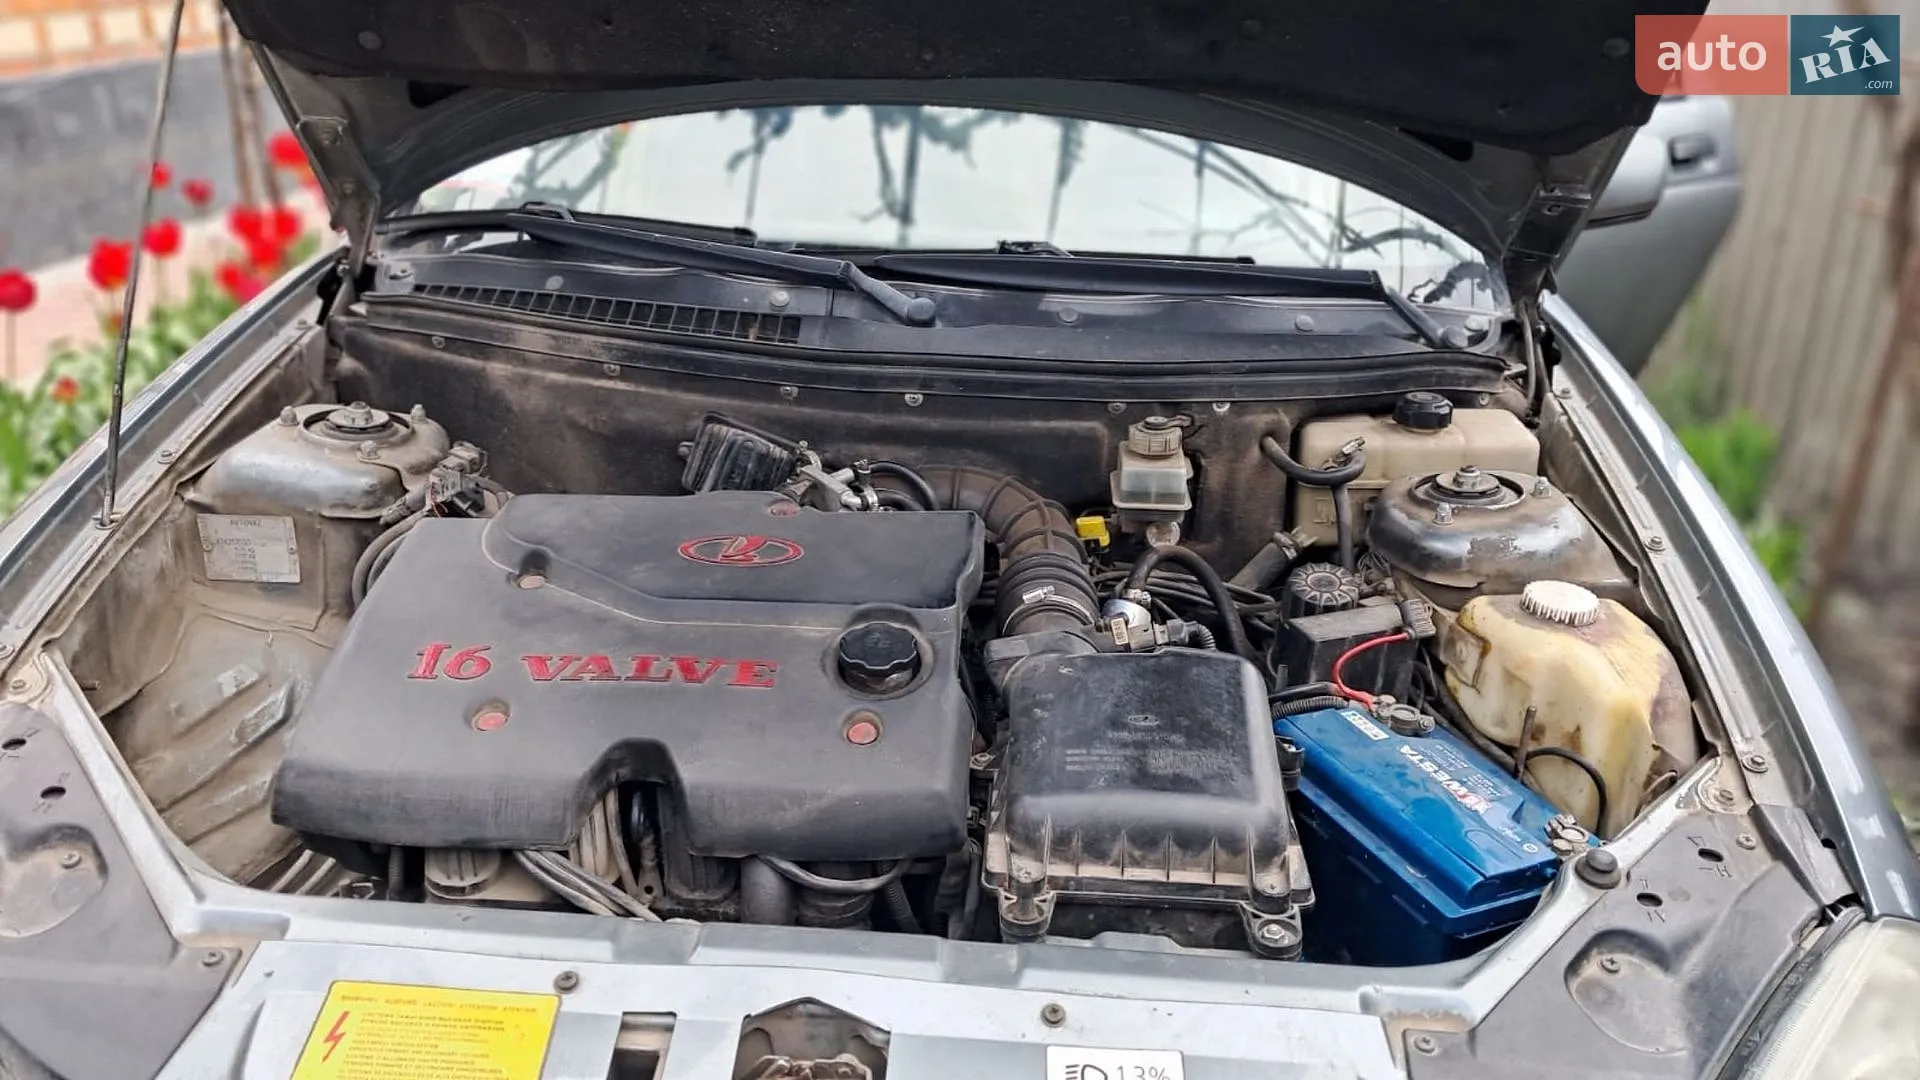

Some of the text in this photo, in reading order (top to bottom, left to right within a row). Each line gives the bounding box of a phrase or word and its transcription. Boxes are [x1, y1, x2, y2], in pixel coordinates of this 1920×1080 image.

[407, 643, 778, 689] 16 VALVE
[1400, 744, 1469, 800] WESTA
